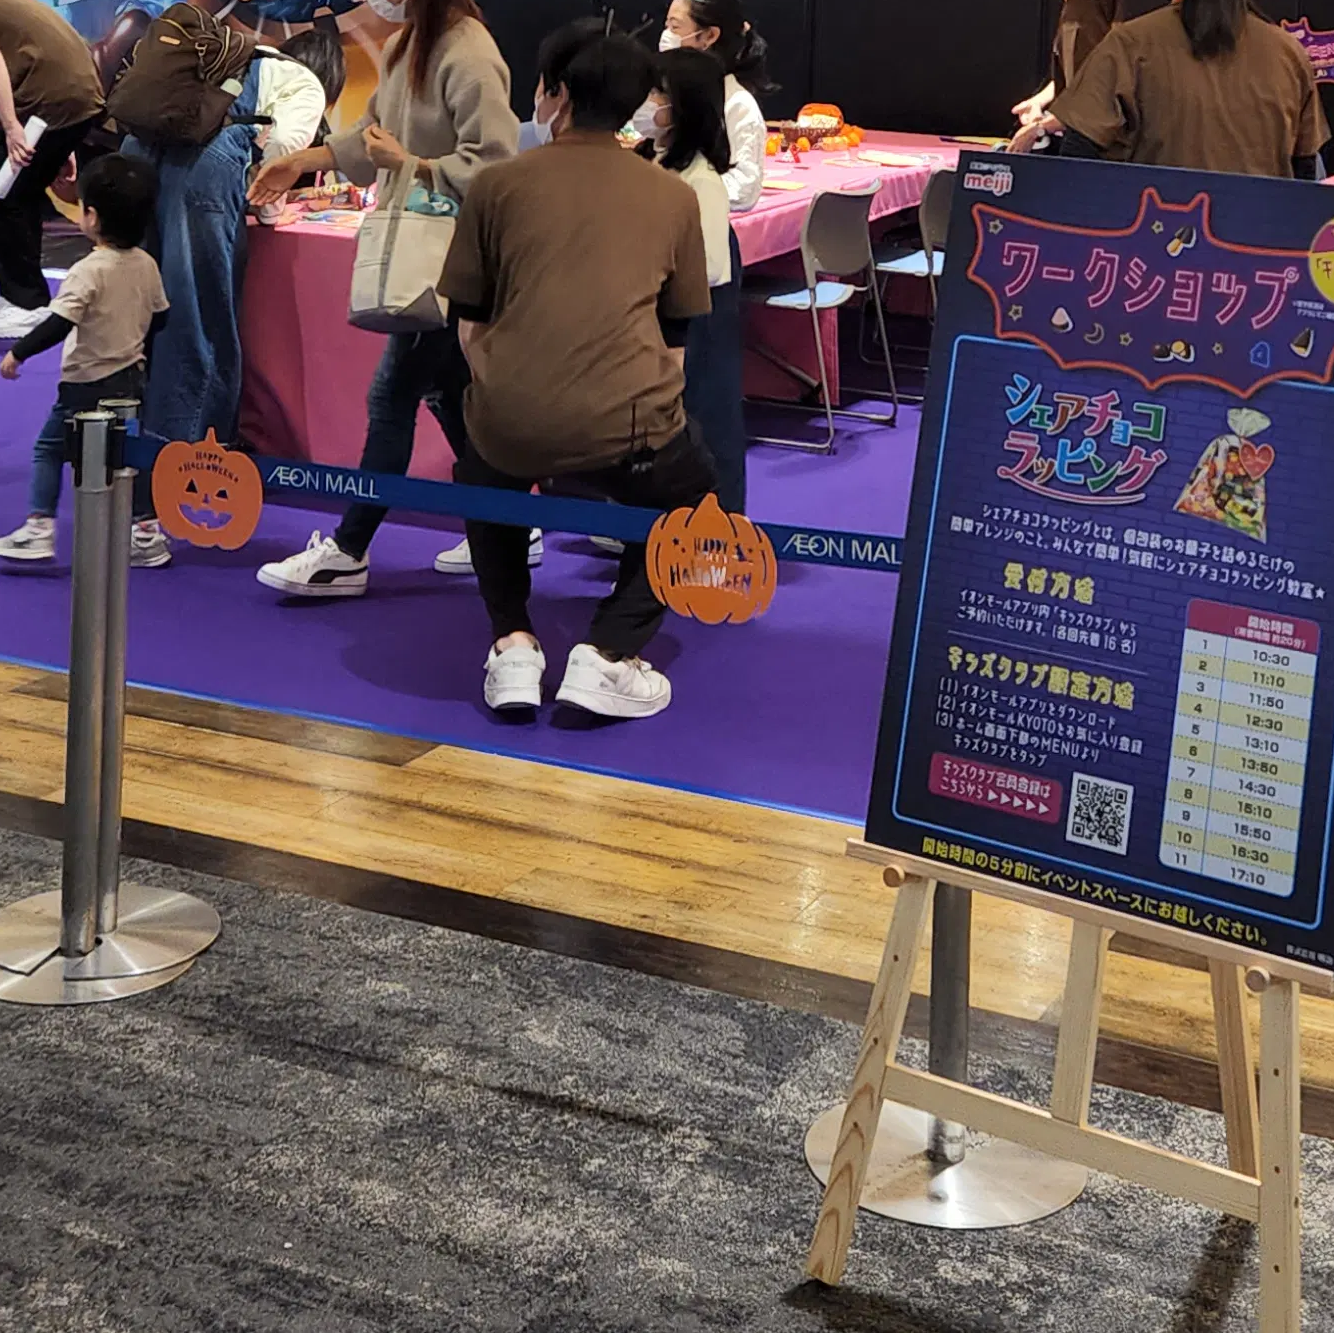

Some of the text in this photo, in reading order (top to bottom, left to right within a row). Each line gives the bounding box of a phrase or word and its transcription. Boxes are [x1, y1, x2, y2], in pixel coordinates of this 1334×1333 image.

[965, 171, 1013, 196] meiji
[1002, 241, 1300, 330] ワークショップ
[1003, 373, 1167, 442] シェアチョコ
[195, 450, 224, 465] HAPPY
[997, 430, 1167, 495] ラッピング
[325, 473, 380, 499] MALL
[693, 536, 728, 558] HAPPY
[851, 542, 902, 565] MAL
[1202, 639, 1290, 667] 1 10:30
[1199, 661, 1285, 688] 2 11:10
[937, 695, 956, 712] (2)
[939, 677, 1117, 730] (1) イオンモールアプリをダウンロード
[1196, 682, 1285, 710] 3 11:50
[935, 712, 954, 728] (3)
[1193, 703, 1283, 732] 4 12:30
[953, 733, 1048, 767] キッズクラブをタップ
[1191, 724, 1280, 753] 5 13:10
[1189, 746, 1278, 775] 6 13:50
[940, 776, 984, 799] こちらから
[1187, 767, 1276, 797] 7 14:30
[1184, 789, 1272, 819] 8 15:10
[1182, 810, 1271, 842] 9 15:50
[1176, 830, 1269, 864] 10 16:30
[1175, 852, 1266, 886] 11 17:10
